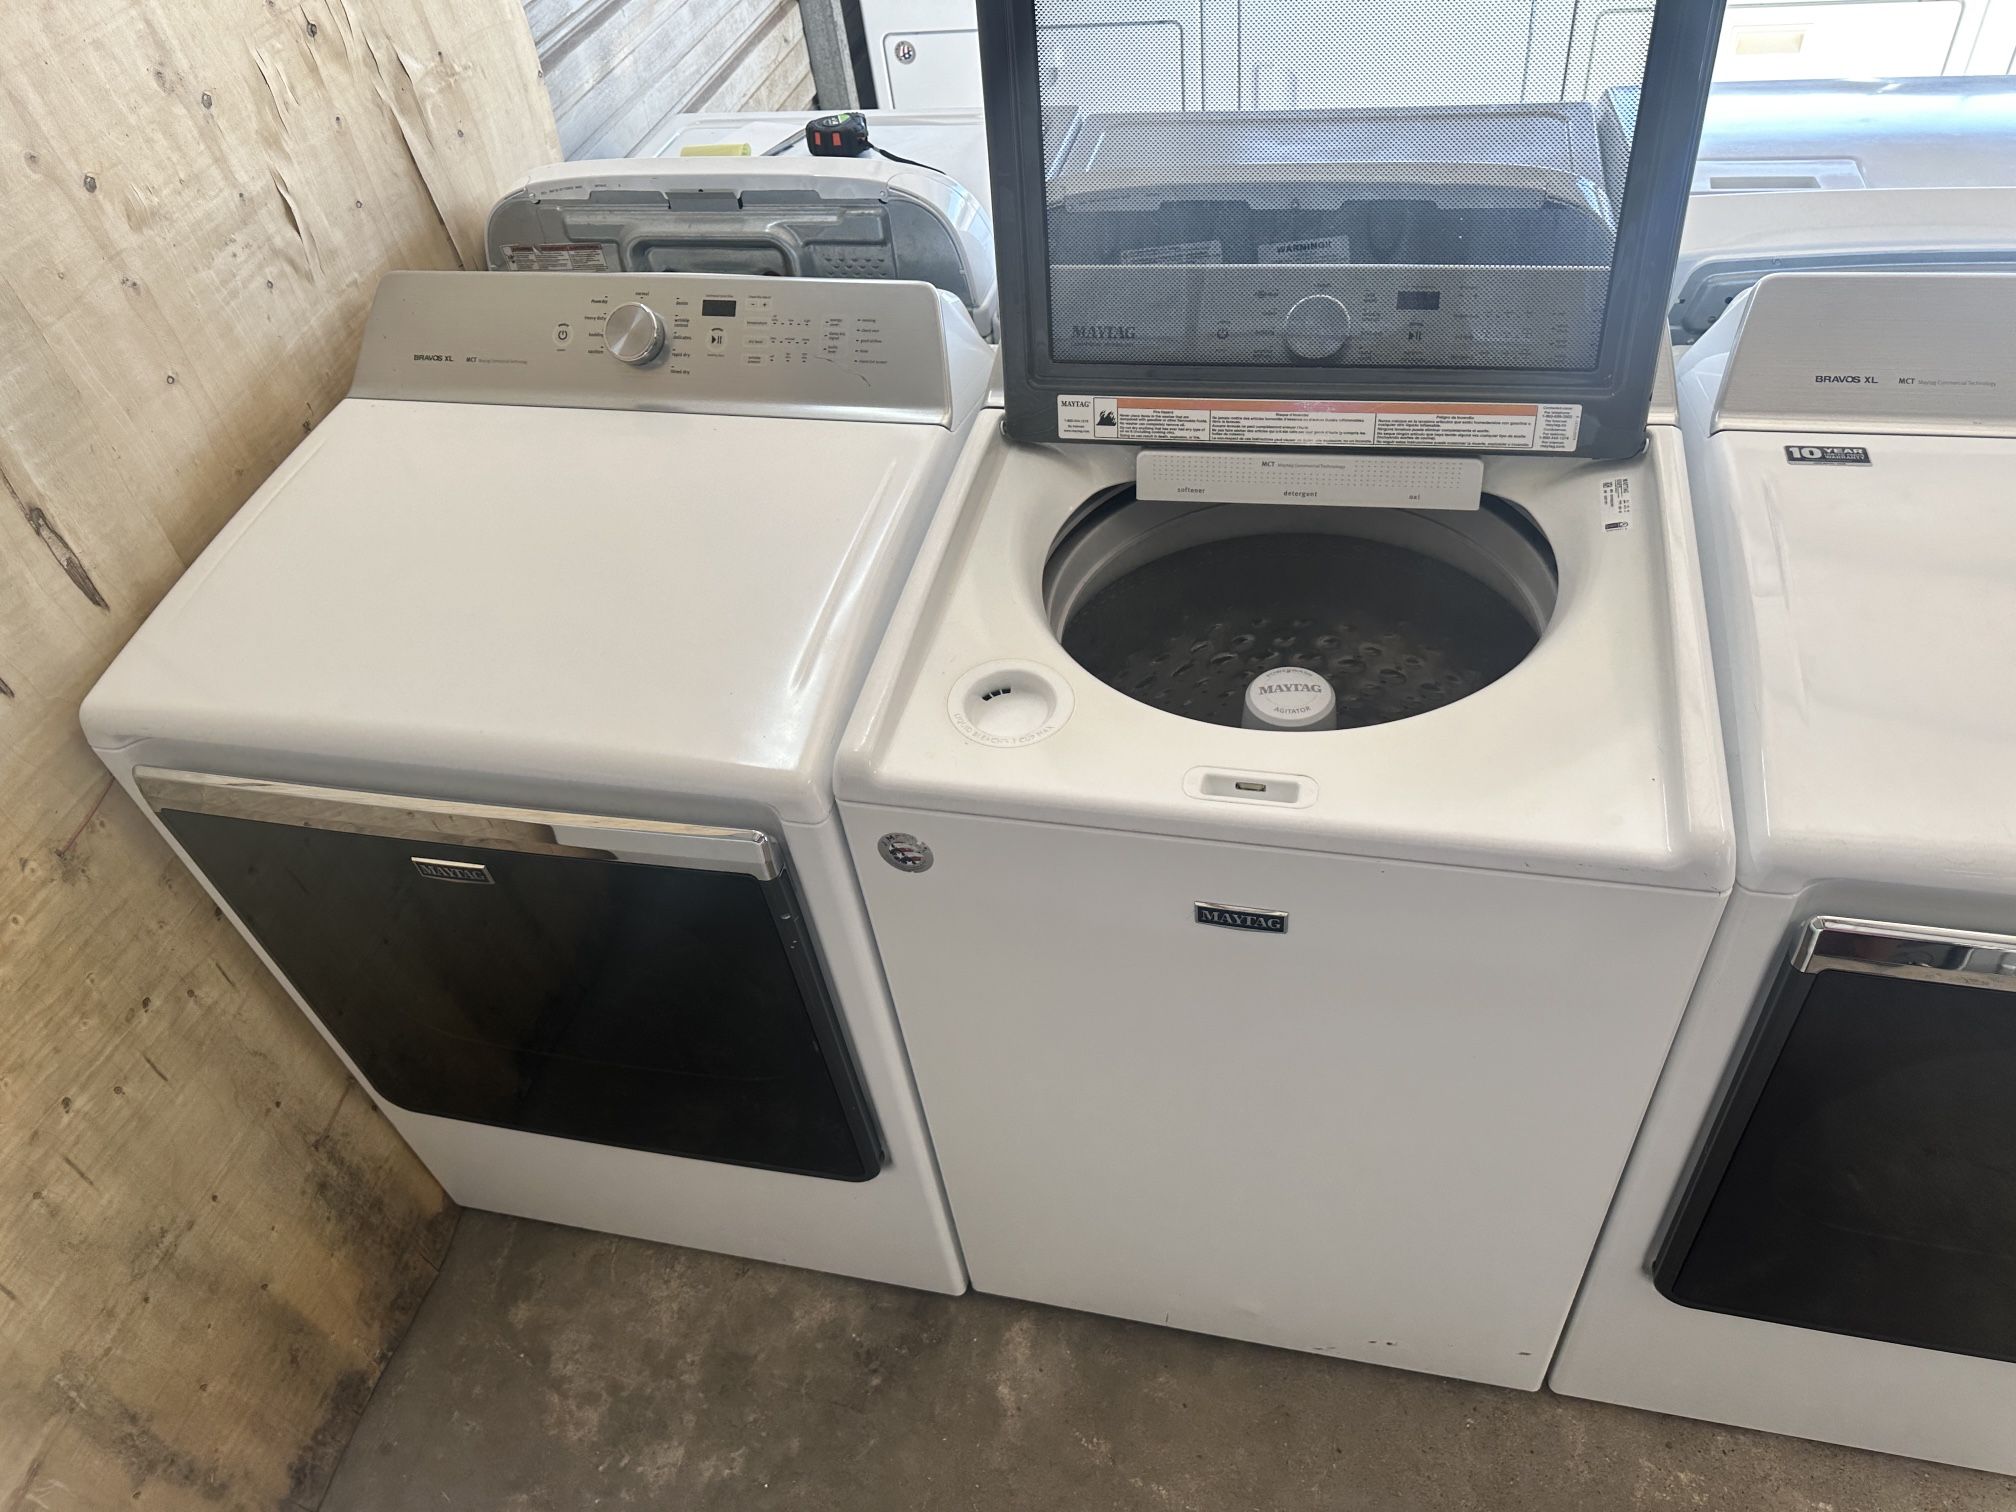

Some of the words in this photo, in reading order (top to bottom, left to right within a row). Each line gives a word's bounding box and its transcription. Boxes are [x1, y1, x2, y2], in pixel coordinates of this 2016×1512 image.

[1072, 326, 1136, 338] MAYTAG
[1815, 375, 1861, 384] BRAVOS
[1864, 376, 1878, 384] XL
[1789, 447, 1822, 458] 10
[1283, 490, 1318, 498] detergent
[1258, 684, 1322, 695] MAYTAG
[1273, 706, 1312, 714] AGITATOR
[420, 864, 486, 880] MAYTAG
[1201, 910, 1280, 929] MAYTAG
